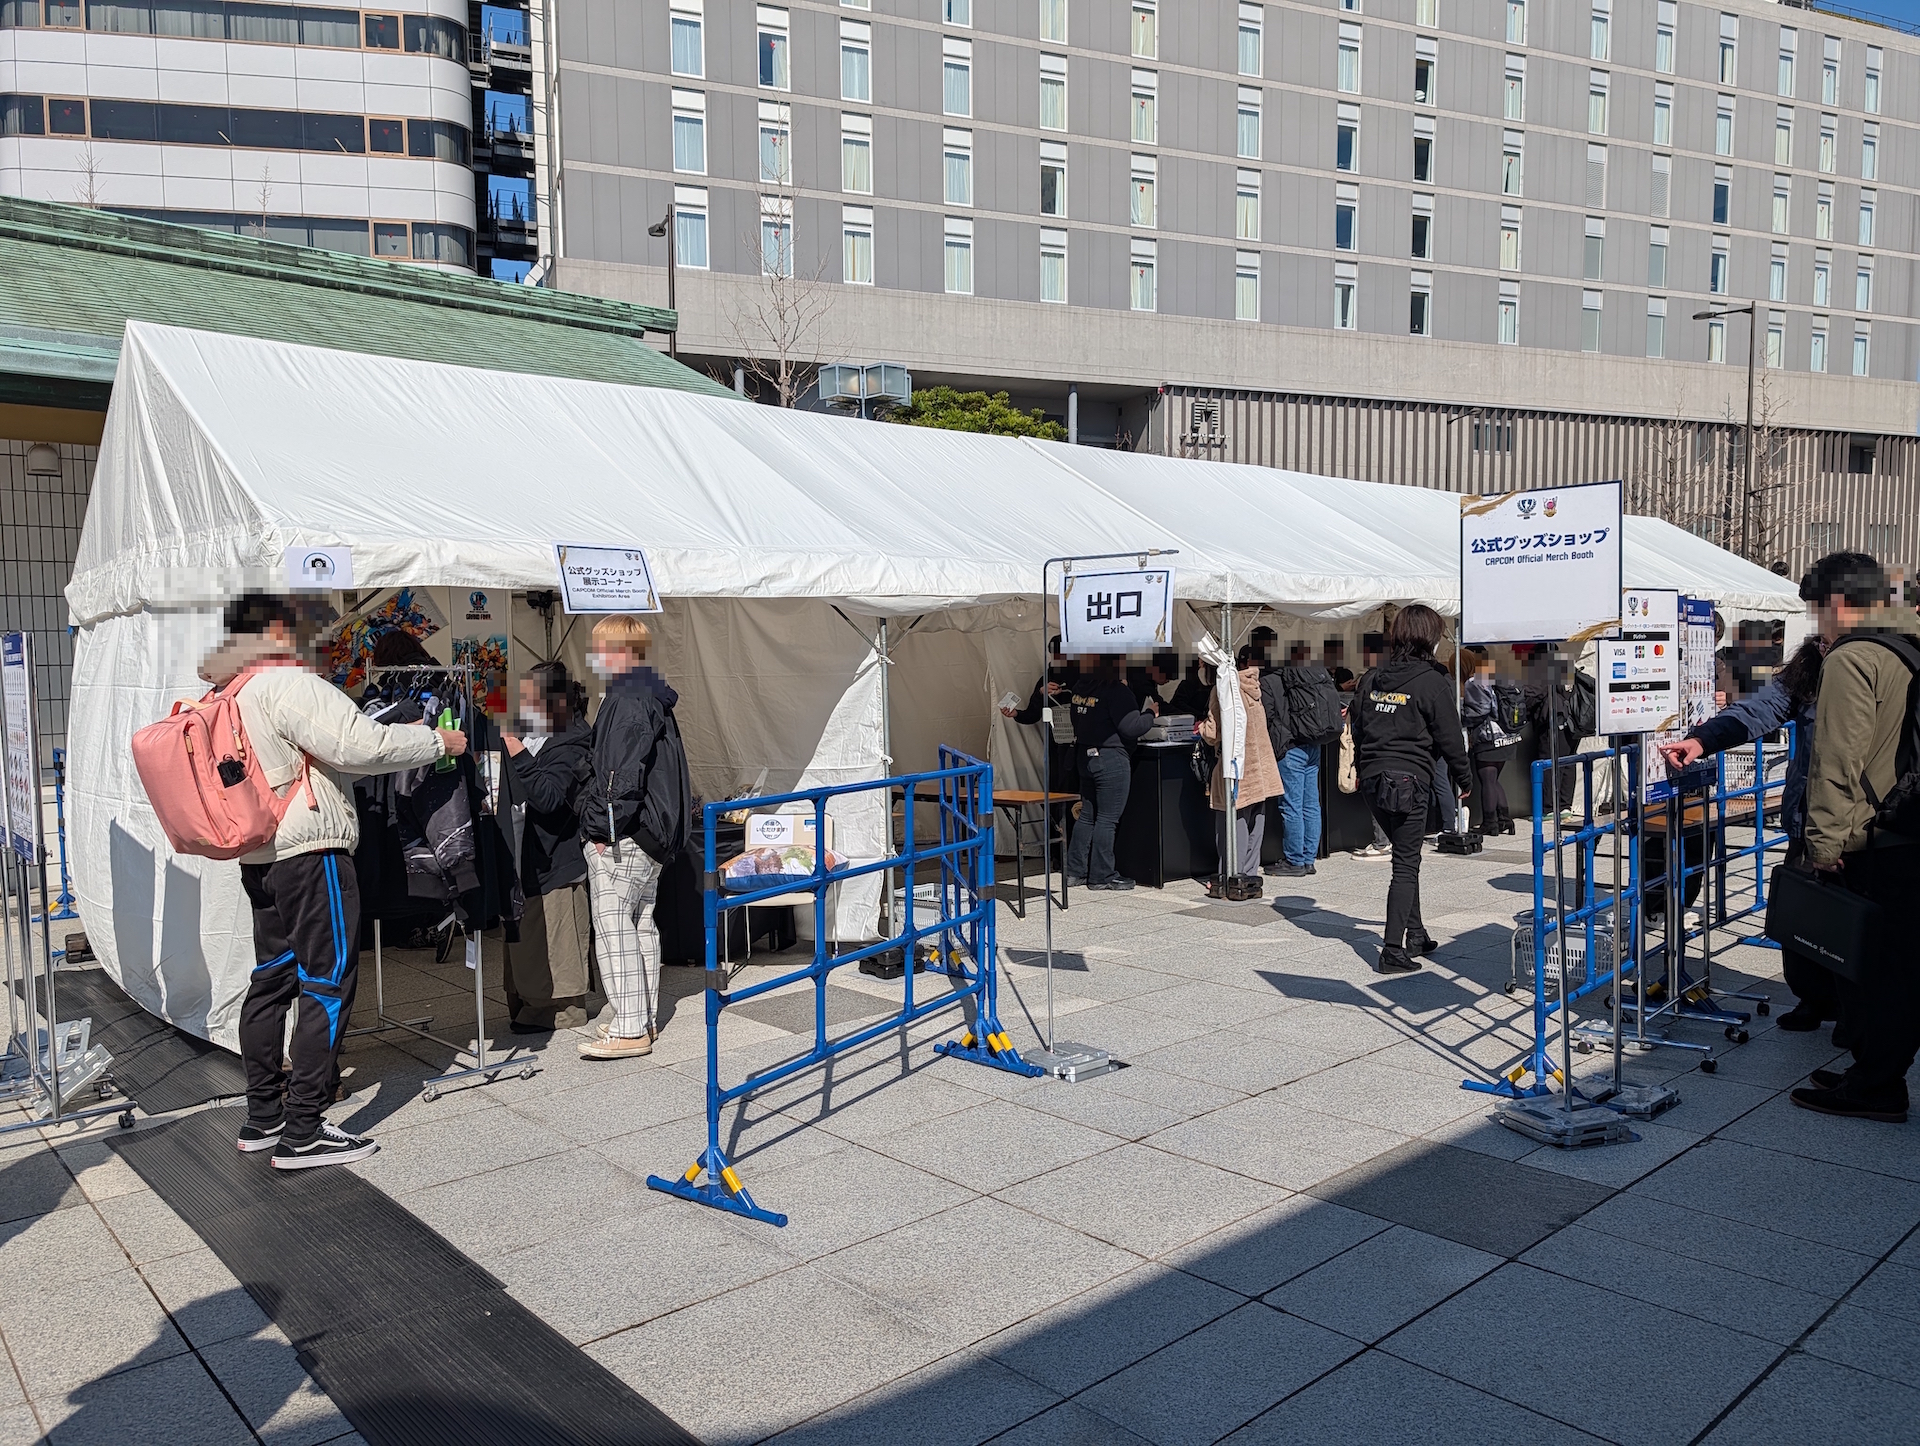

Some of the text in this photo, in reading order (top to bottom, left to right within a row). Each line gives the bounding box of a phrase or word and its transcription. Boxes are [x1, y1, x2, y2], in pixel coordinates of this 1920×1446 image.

[1471, 527, 1610, 554] 公式グッズショップ
[1485, 550, 1594, 566] CAPCOM Official Merch Booth
[567, 566, 641, 577] 公式グッズショップ
[582, 577, 632, 586] 展示コーナー
[1086, 591, 1142, 622] 出口
[1103, 625, 1125, 635] Exit
[1614, 648, 1626, 656] VISA
[1375, 703, 1397, 713] STAFF
